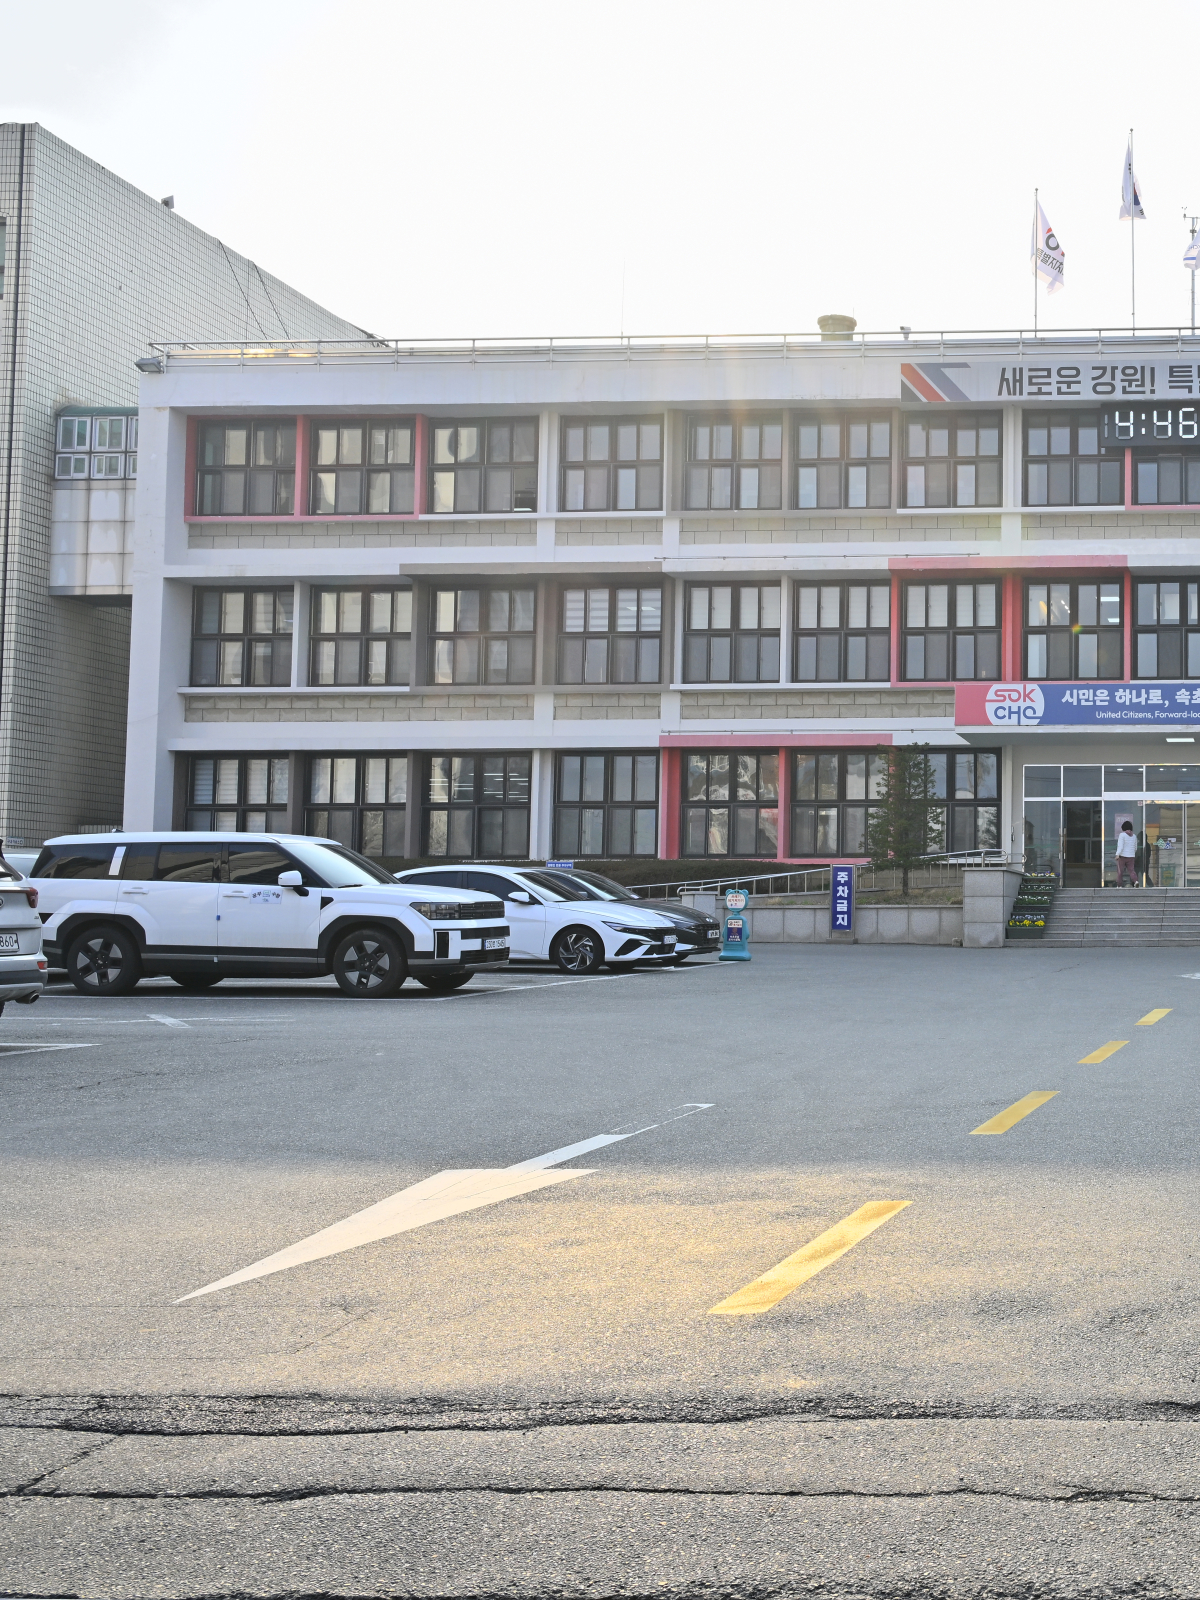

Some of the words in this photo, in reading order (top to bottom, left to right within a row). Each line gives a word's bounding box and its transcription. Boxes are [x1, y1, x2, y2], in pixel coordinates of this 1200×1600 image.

[997, 363, 1082, 398] 새로운
[1090, 365, 1156, 396] 강원!
[1061, 689, 1110, 706] 시민은
[1115, 688, 1169, 708] 하나로,
[1096, 710, 1121, 719] United
[1123, 710, 1154, 721] Citizens,
[836, 871, 849, 926] 주차금지
